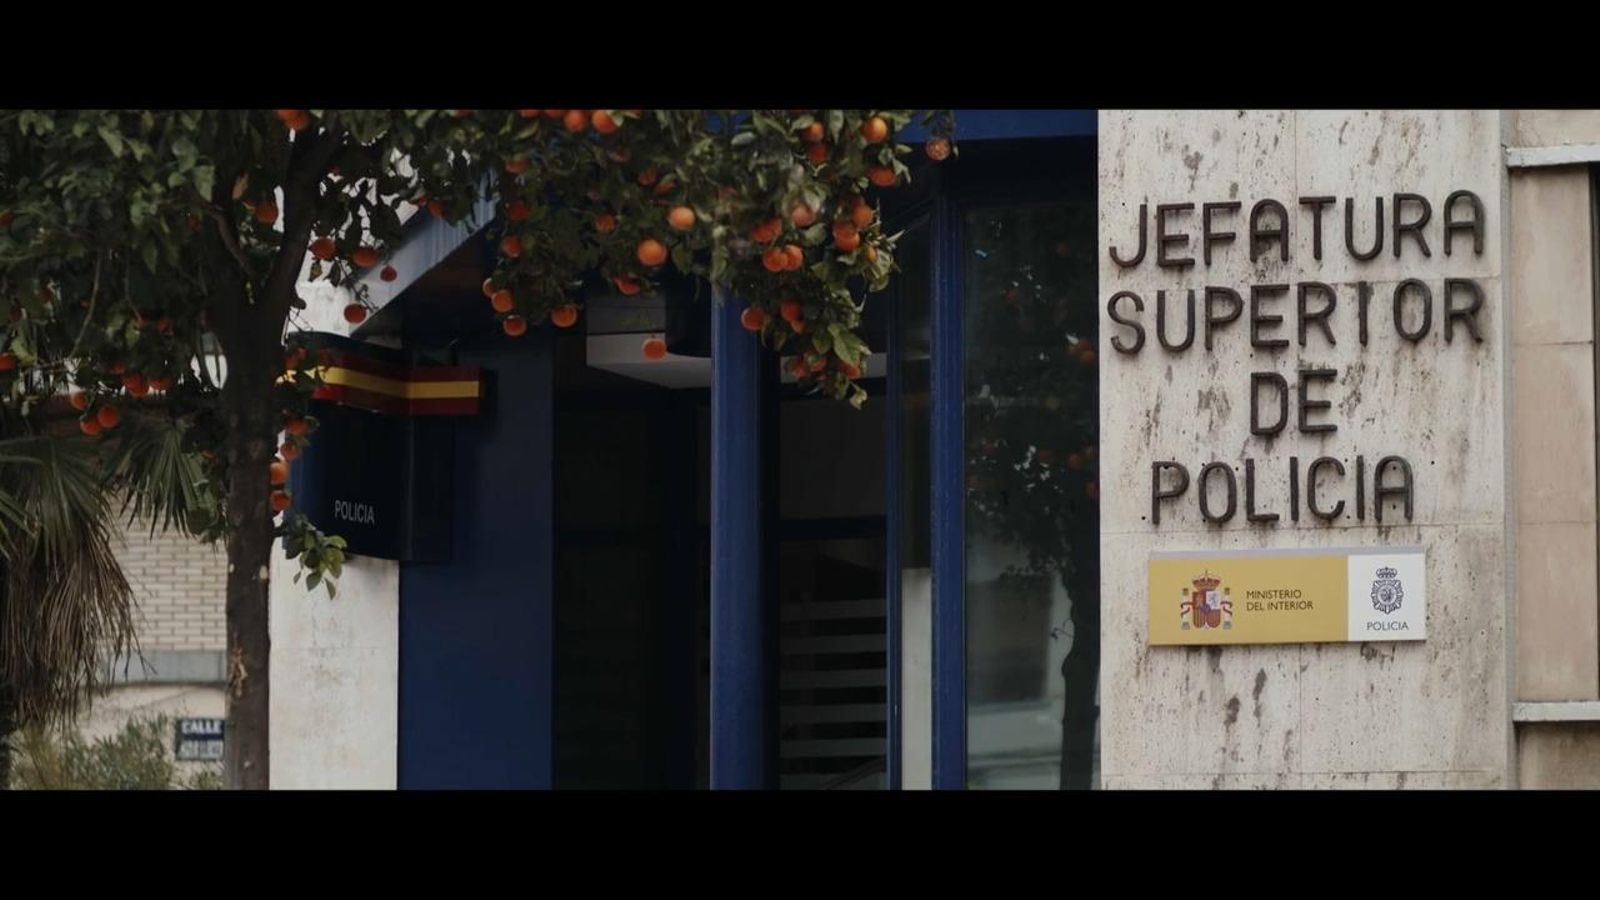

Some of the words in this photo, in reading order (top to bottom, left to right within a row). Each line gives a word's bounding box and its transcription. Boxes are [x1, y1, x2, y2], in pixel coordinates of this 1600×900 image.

[1109, 189, 1484, 268] JEFATURA
[1107, 278, 1484, 355] SUPERIOR
[1250, 369, 1338, 436] DE
[1151, 455, 1414, 525] POLICIA
[334, 499, 375, 524] POLICIA
[1246, 589, 1302, 600] MINISTERIO
[1246, 602, 1265, 611] DEL
[1267, 600, 1314, 611] INTERIOR
[1366, 621, 1409, 631] POLICIA
[181, 720, 221, 735] CALLE
